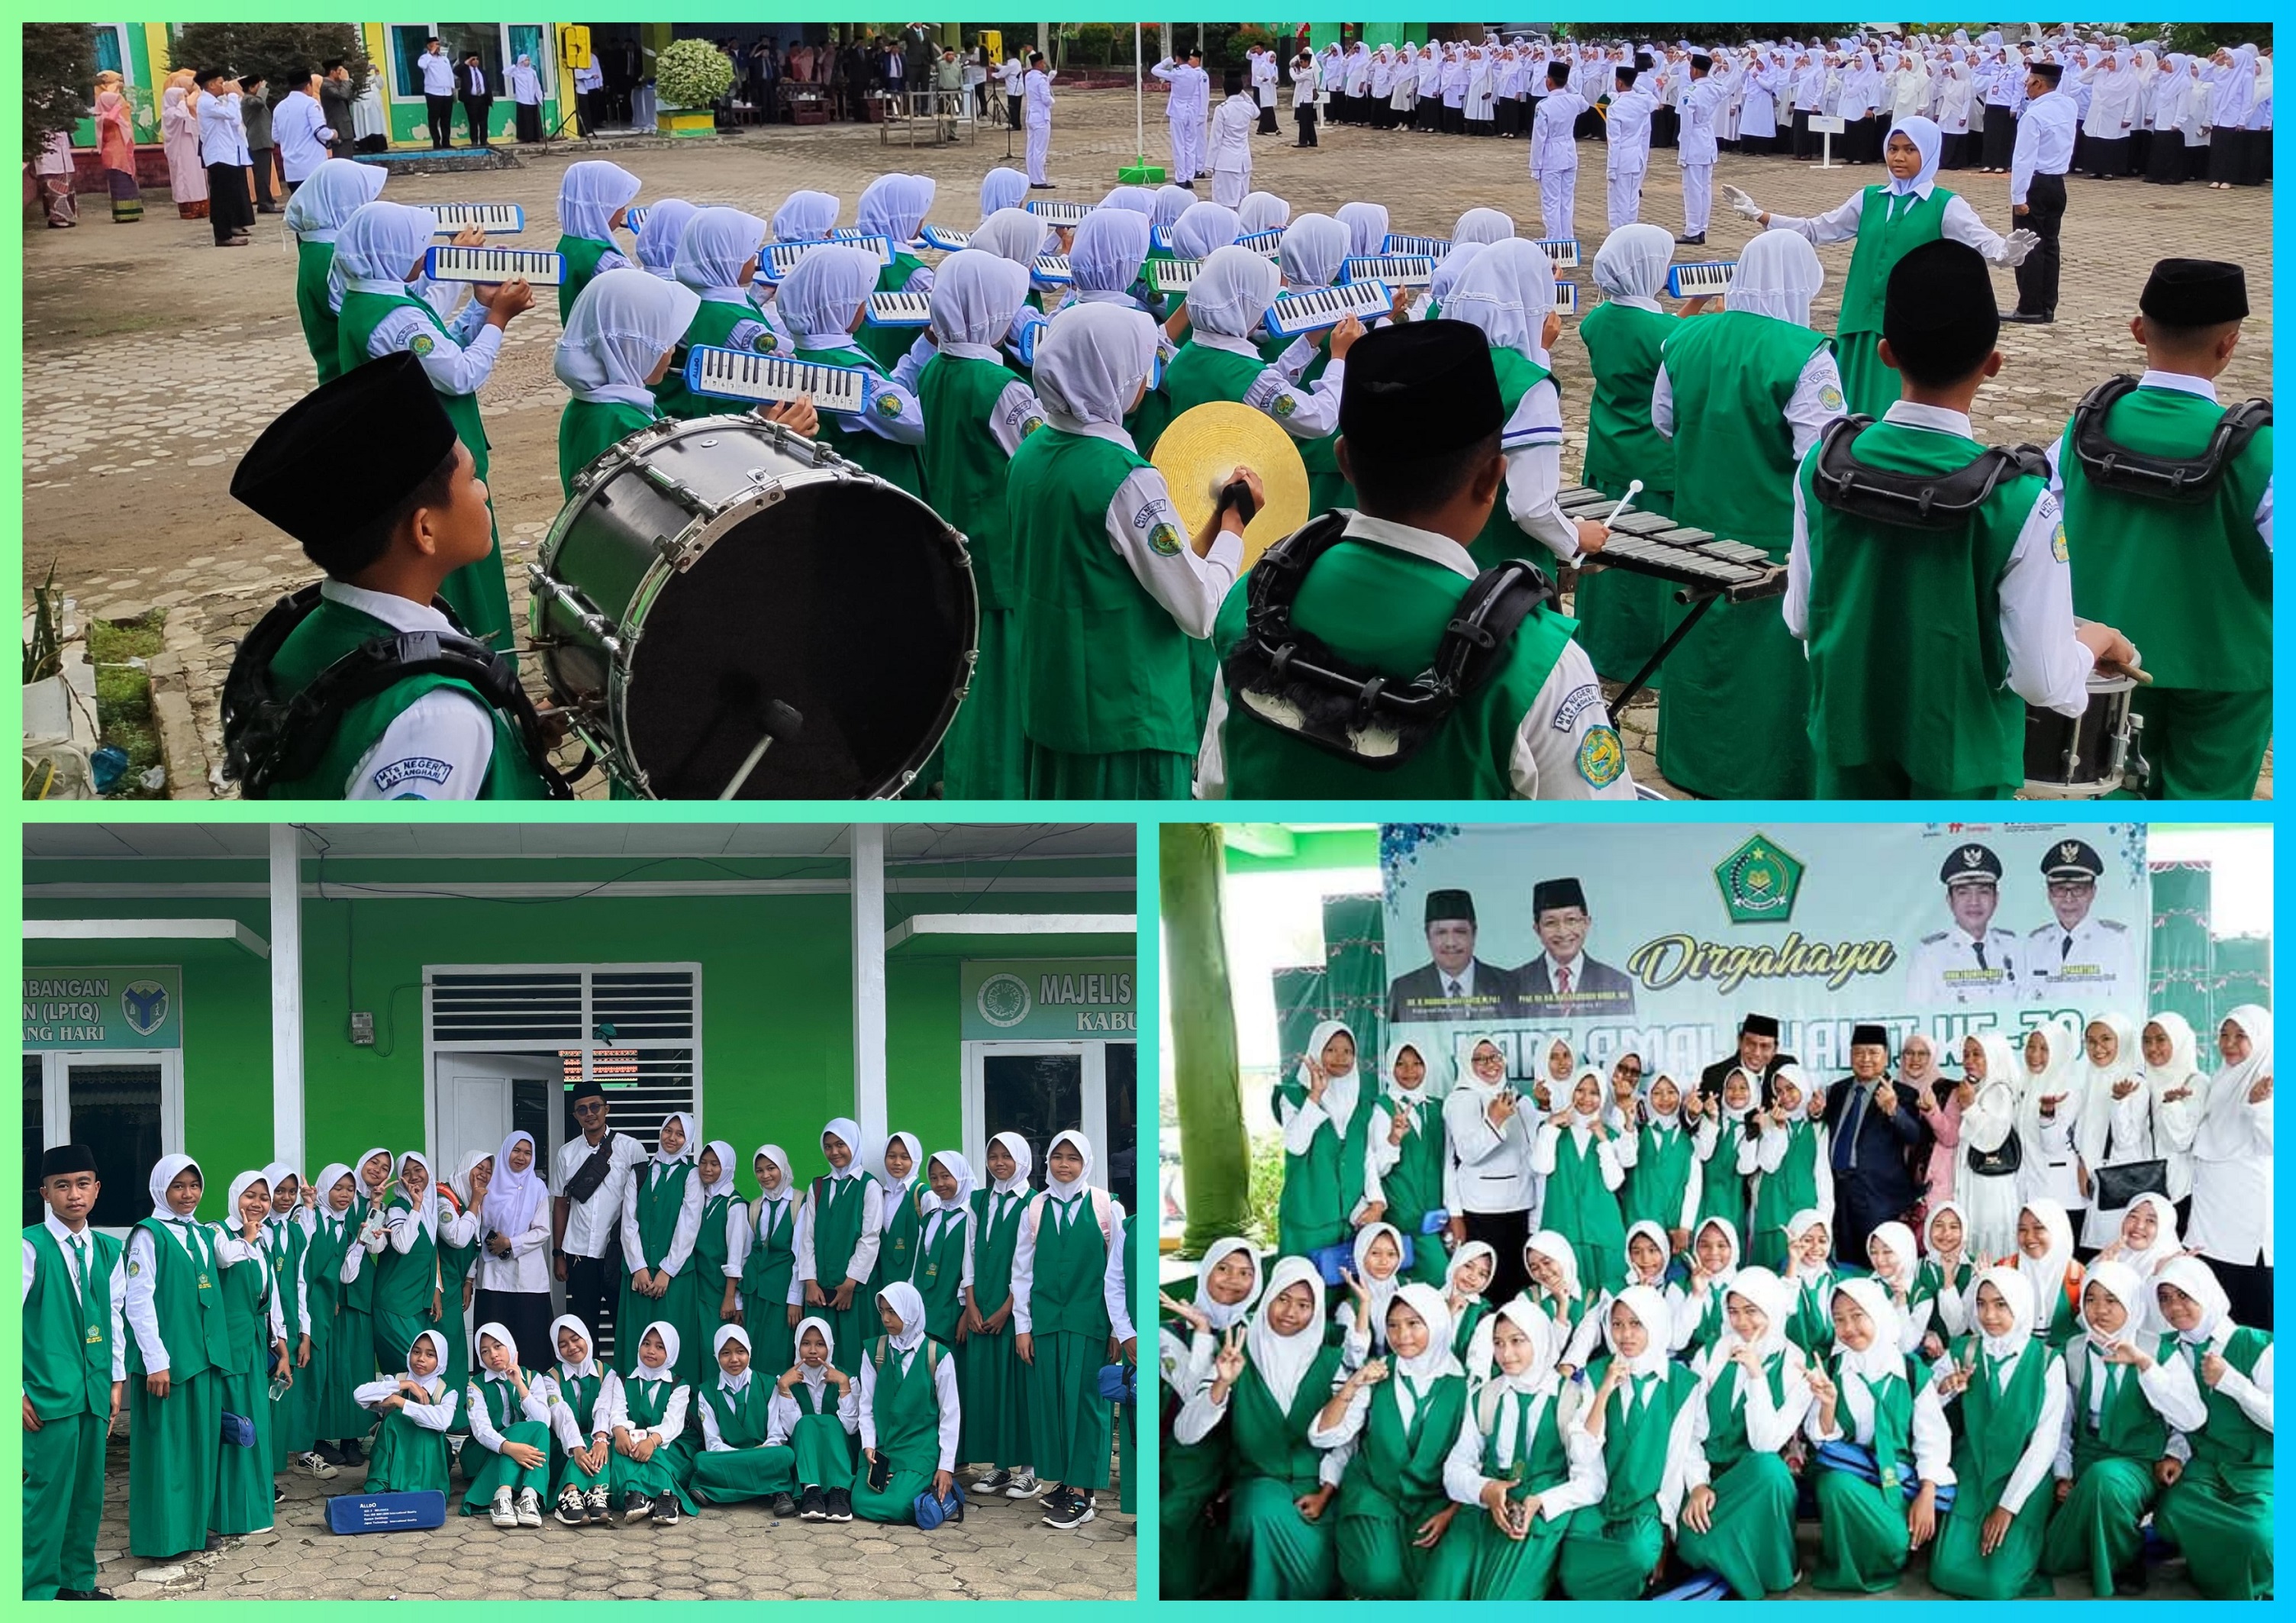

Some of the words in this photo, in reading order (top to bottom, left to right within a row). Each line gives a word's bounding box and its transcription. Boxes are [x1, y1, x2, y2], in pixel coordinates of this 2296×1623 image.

[1568, 688, 1592, 705] NEGERI
[379, 766, 400, 780] MTs
[404, 760, 441, 772] NEGERI
[1627, 932, 1897, 995] Dirgahayu
[1040, 973, 1131, 1005] MAJELIS
[43, 1002, 99, 1024] (LPTQ)
[60, 1026, 105, 1041] HARI
